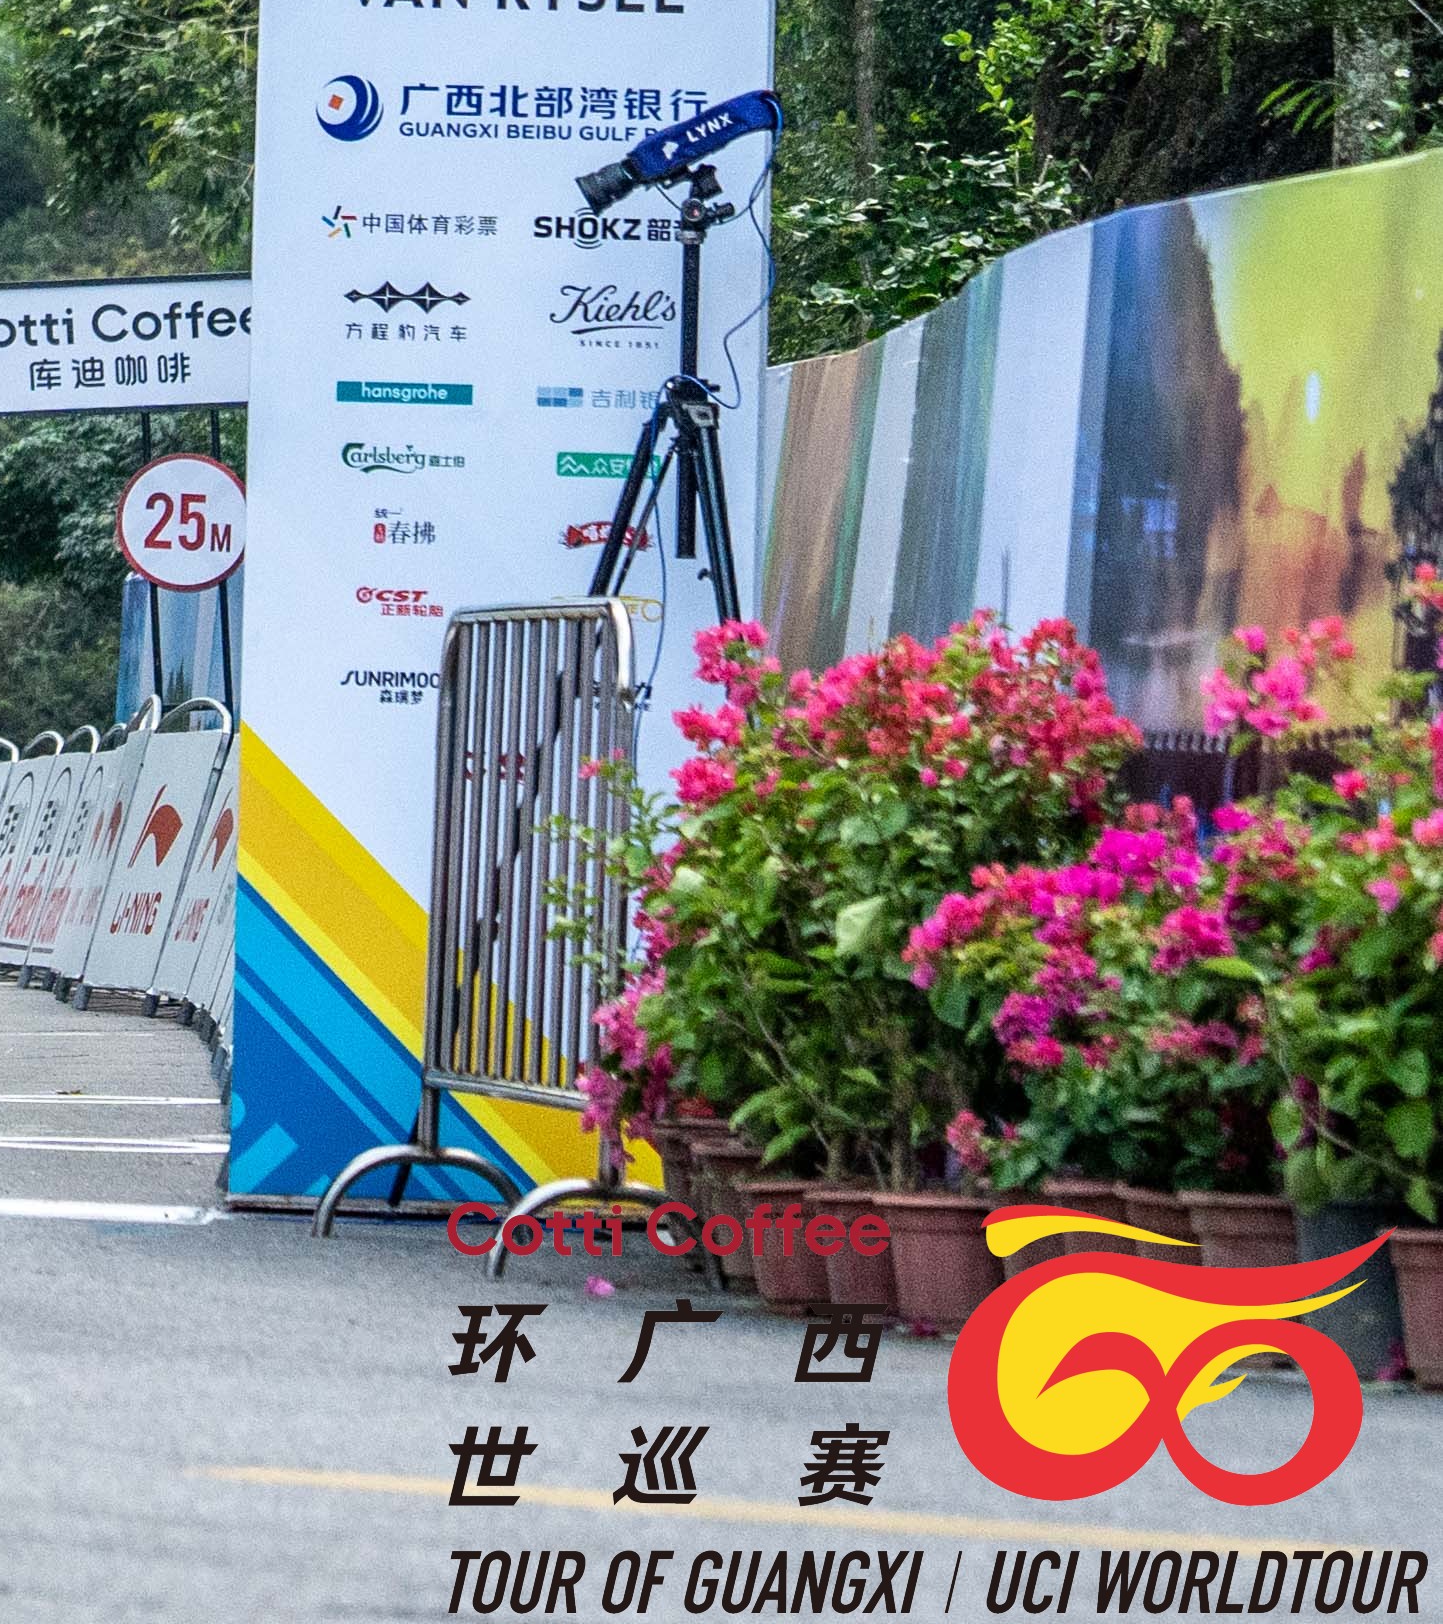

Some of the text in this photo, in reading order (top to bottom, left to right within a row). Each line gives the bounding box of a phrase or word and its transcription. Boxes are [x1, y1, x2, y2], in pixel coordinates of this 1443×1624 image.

[400, 82, 710, 121] 广西北部湾银行
[399, 121, 499, 139] GUANGXI
[507, 123, 573, 140] BEIBU
[579, 124, 637, 141] GULF
[685, 112, 734, 144] LYNX
[362, 212, 498, 236] 中国体育彩票
[533, 215, 641, 242] SHOKZ
[549, 284, 678, 324] Kiehl's
[346, 322, 467, 342] 方程豹汽车
[29, 352, 191, 391] 库迪咖啡
[360, 381, 449, 402] hansgrohe
[341, 442, 427, 471] Carlsberg
[144, 492, 232, 553] 25M
[375, 589, 430, 603] CST
